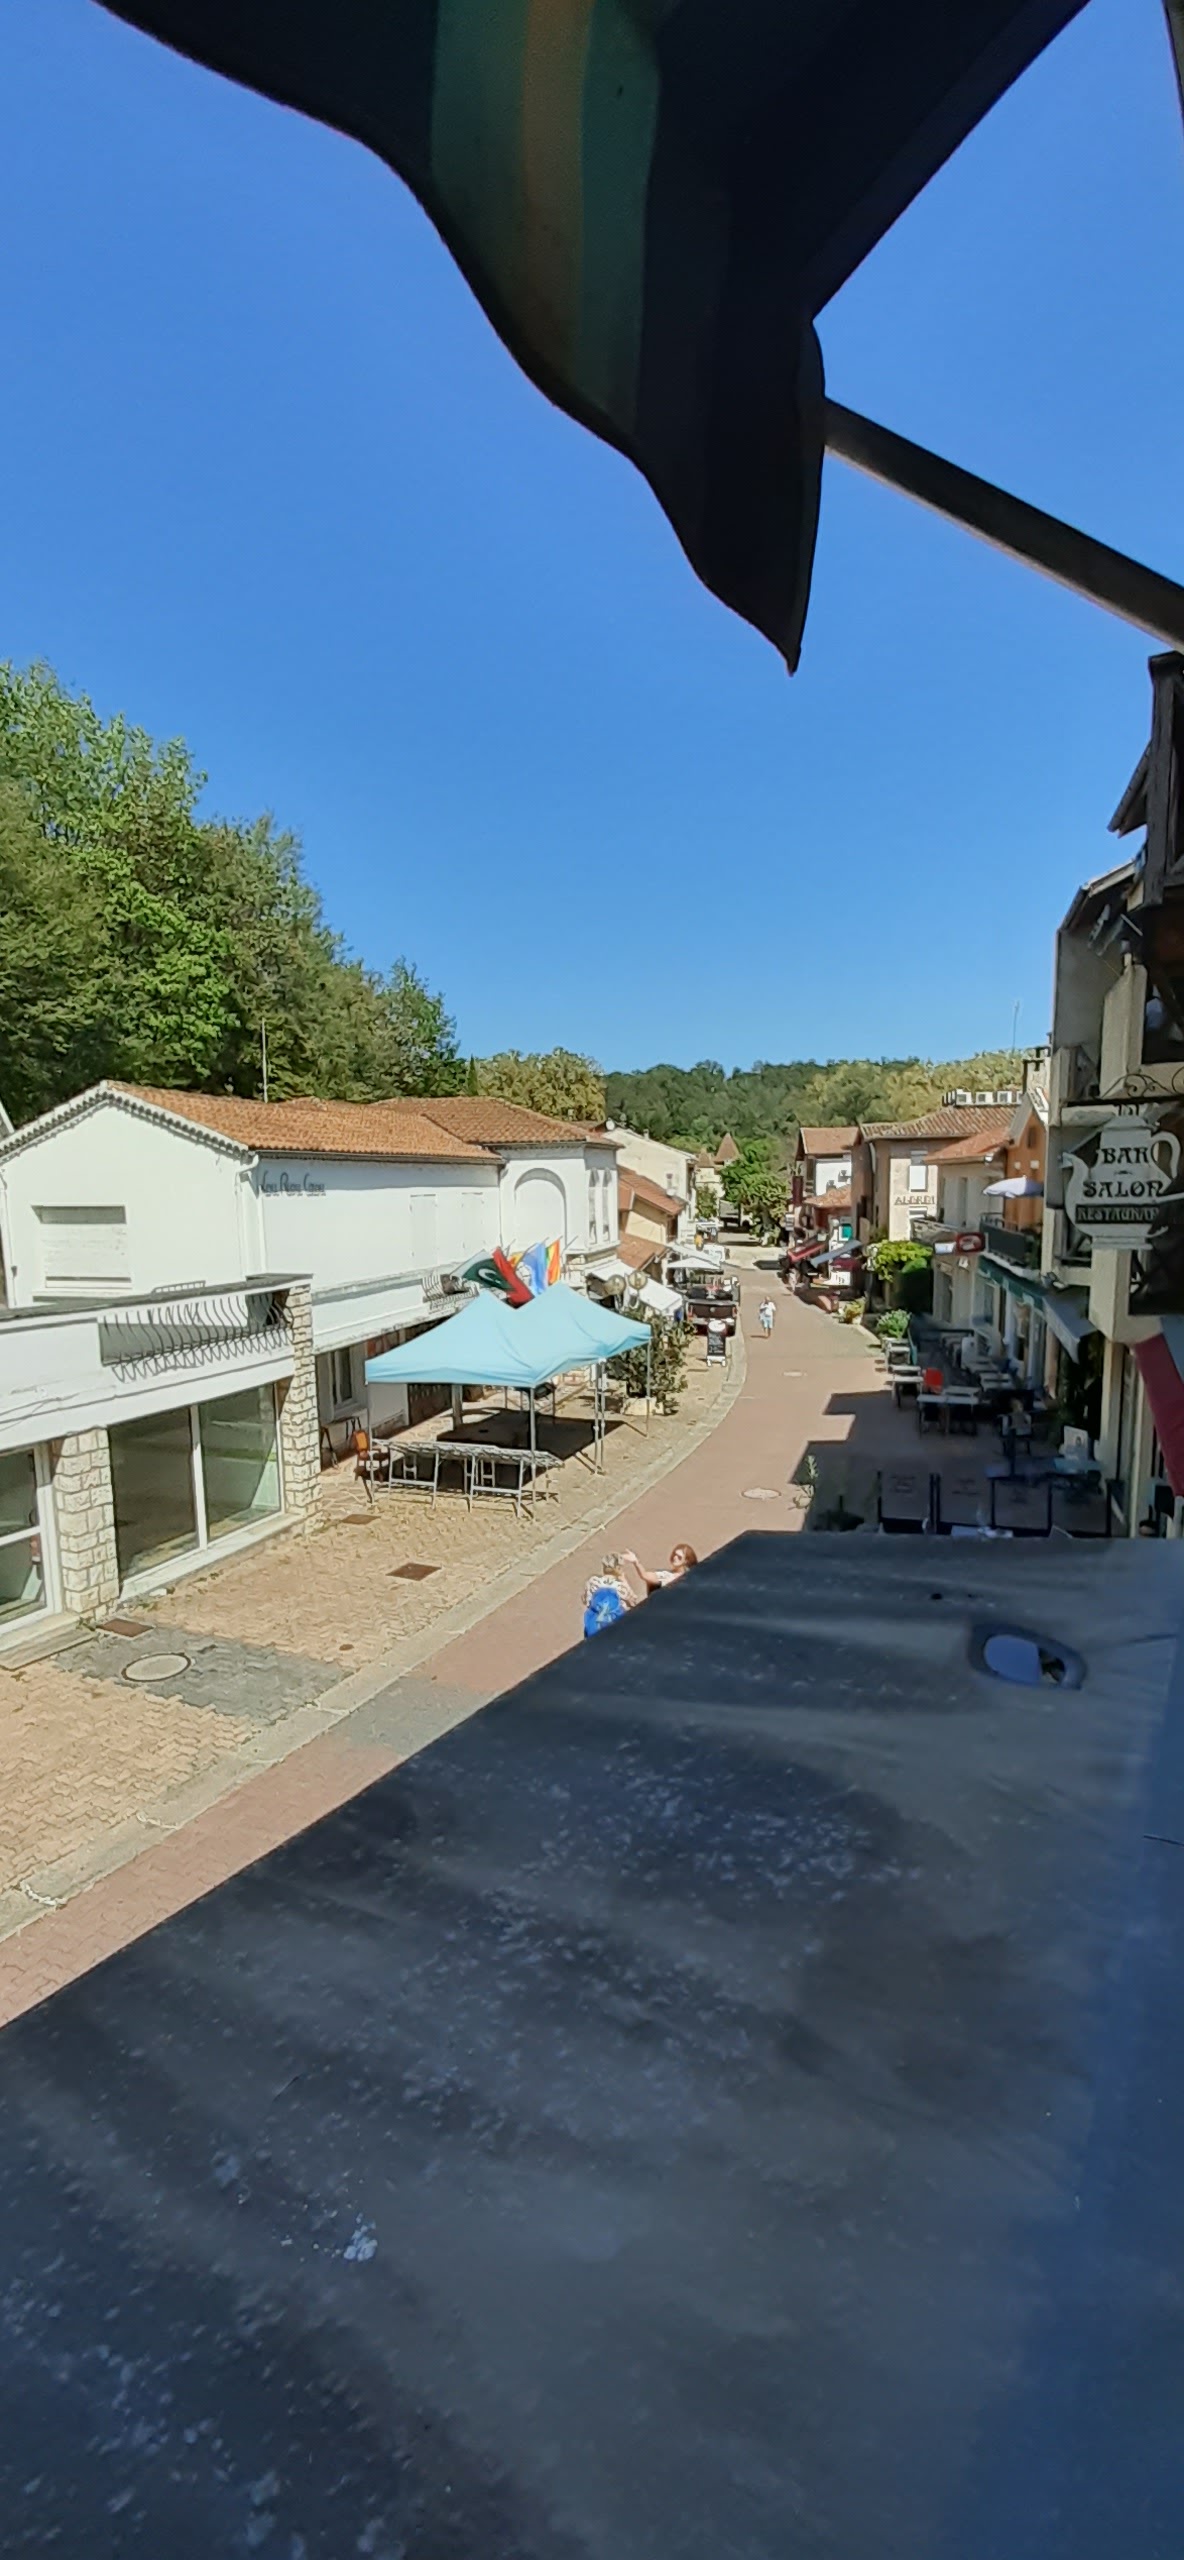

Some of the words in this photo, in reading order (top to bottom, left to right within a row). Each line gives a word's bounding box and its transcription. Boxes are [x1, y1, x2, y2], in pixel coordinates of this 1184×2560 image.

[1101, 1147, 1149, 1164] BAR
[1082, 1180, 1164, 1198] SALON
[1077, 1207, 1160, 1221] RESTAURAN
